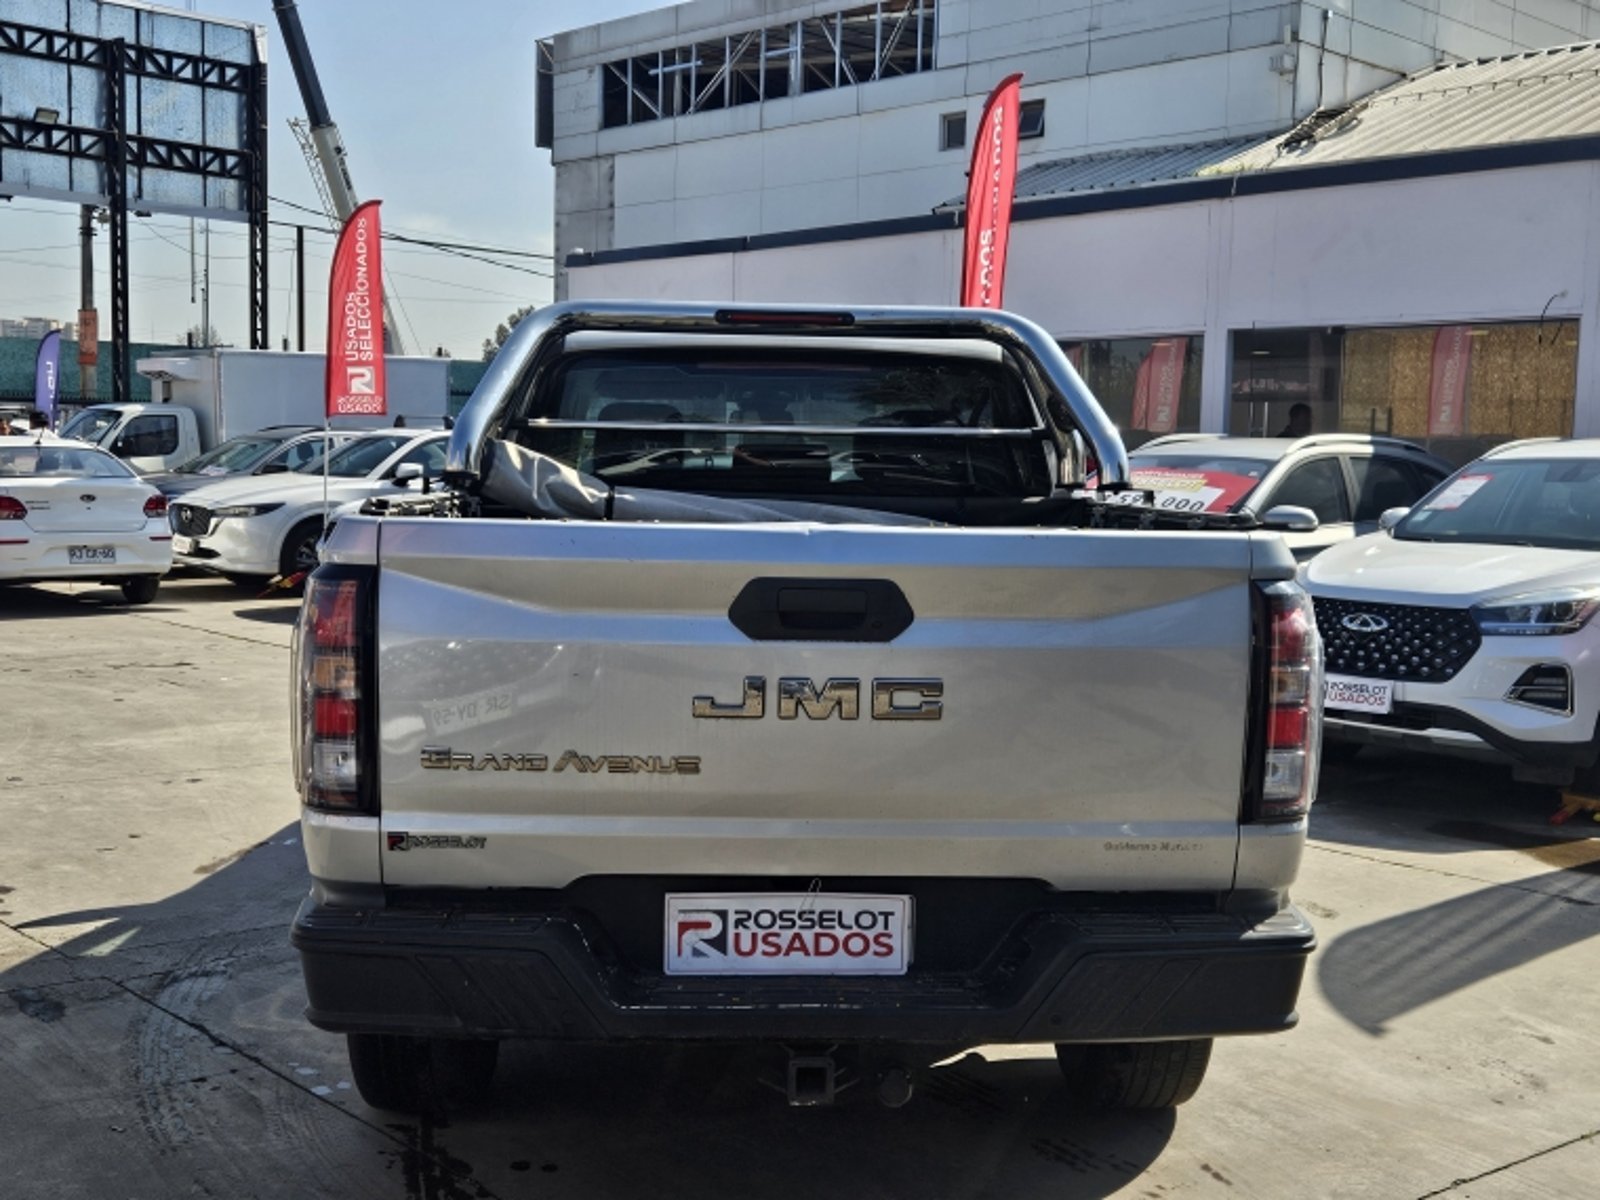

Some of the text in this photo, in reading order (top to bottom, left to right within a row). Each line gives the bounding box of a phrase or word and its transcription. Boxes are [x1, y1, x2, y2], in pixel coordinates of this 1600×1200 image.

[355, 217, 374, 361] SELECCIONADOS
[345, 291, 359, 361] USADOS
[692, 675, 944, 720] JMC
[420, 745, 702, 775] GRAND AVENUE
[734, 909, 895, 931] ROSSELOT
[733, 932, 895, 958] USADOS
